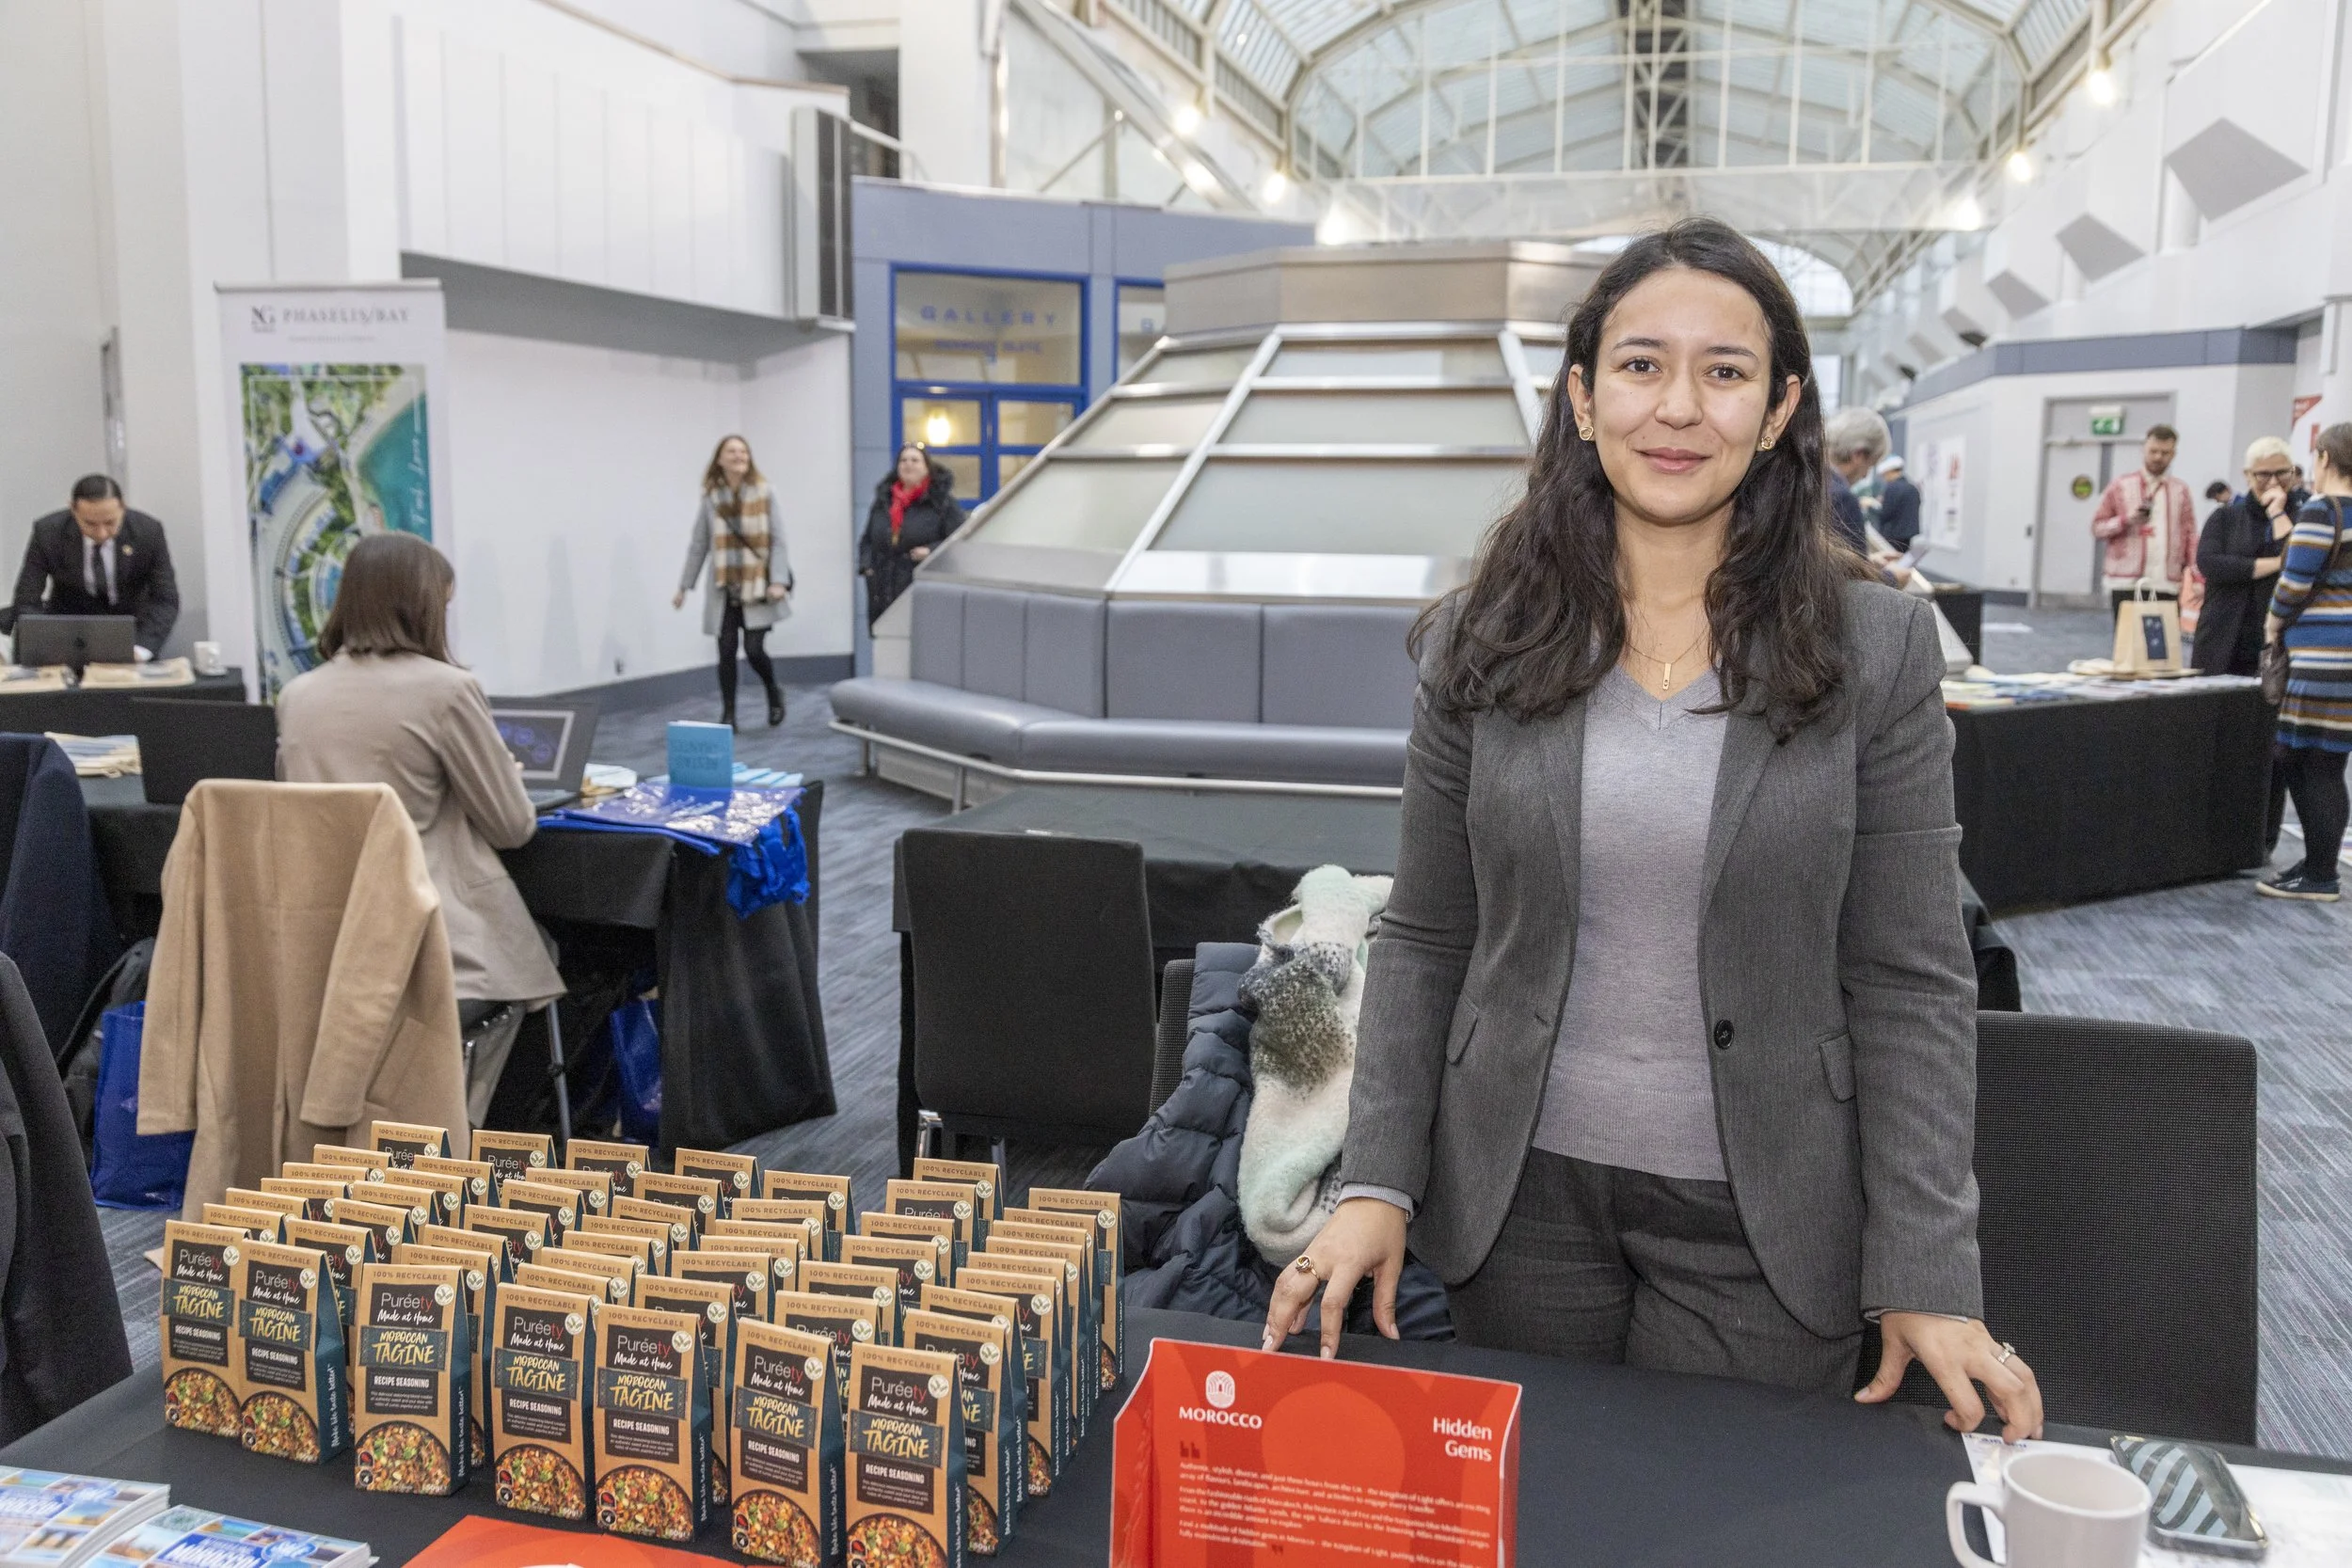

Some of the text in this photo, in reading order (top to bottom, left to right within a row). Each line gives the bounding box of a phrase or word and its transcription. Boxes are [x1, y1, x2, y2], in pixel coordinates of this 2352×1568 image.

[499, 1138, 539, 1148] RECYCLABLE
[595, 1149, 636, 1158] RECYCLABLE
[311, 1172, 355, 1180] RECYCLABLE
[554, 1178, 598, 1186] RECYCLABLE
[290, 1187, 334, 1196] RECYCLABLE
[664, 1181, 707, 1192] RECYCLABLE
[794, 1180, 838, 1189] RECYCLABLE
[379, 1193, 421, 1203] RECYCLABLE
[917, 1189, 963, 1197] RECYCLABLE
[1060, 1197, 1108, 1207] RECYCLABLE
[591, 1222, 659, 1235] 100% RECYCLABLE
[893, 1222, 942, 1232] RECYCLABLE
[192, 1231, 235, 1242] RECYCLABLE
[314, 1229, 356, 1242] RECYCLABLE
[593, 1242, 638, 1252] RECYCLABLE
[734, 1246, 785, 1255] RECYCLABLE
[875, 1246, 926, 1256] RECYCLABLE
[1019, 1248, 1070, 1259] RECYCLABLE
[268, 1252, 310, 1264] RECYCLABLE
[410, 1252, 477, 1266] 100% RECYCLABLE
[706, 1259, 756, 1268] RECYCLABLE
[1001, 1263, 1053, 1274] RECYCLABLE
[396, 1272, 447, 1281] RECYCLABLE
[527, 1274, 596, 1291] 100% RECYCLABLE
[810, 1270, 884, 1283] 100% RECYCLABLE
[179, 1285, 218, 1300] MOROCCAN
[646, 1283, 719, 1298] 100% RECYCLABLE
[991, 1279, 1042, 1291] RECYCLABLE
[173, 1295, 224, 1319] TAGINE
[506, 1293, 577, 1309] 100% RECYCLABLE
[787, 1302, 865, 1315] 100% RECYCLABLE
[256, 1307, 295, 1324] MOROCCAN
[377, 1308, 435, 1324] Made at Home
[608, 1311, 684, 1328] 100% RECYCLABLE
[175, 1324, 221, 1341] RECIPE SEASONING
[250, 1317, 301, 1341] TAGINE
[380, 1331, 428, 1343] MOROCCAN
[511, 1333, 565, 1352] Made at Home
[769, 1335, 817, 1354] RECYCLABLE
[252, 1347, 298, 1366] RECIPE SEASONING
[373, 1341, 434, 1366] TAGINE
[514, 1355, 560, 1371] MOROCCAN
[614, 1354, 673, 1371] Made at Home
[887, 1354, 941, 1370] RECYCLABLE
[374, 1376, 429, 1388] RECIPE SEASONING
[506, 1366, 566, 1392] TAGINE
[617, 1375, 666, 1389] MOROCCAN
[751, 1372, 804, 1396] Made at Home
[610, 1386, 674, 1411] TAGINE
[867, 1394, 929, 1416] Made at Home
[509, 1399, 562, 1416] RECIPE SEASONING
[754, 1396, 799, 1417] MOROCCAN
[746, 1407, 804, 1437] TAGINE
[1179, 1406, 1263, 1430] MOROCCO
[612, 1418, 670, 1435] RECIPE SEASONING
[871, 1418, 922, 1436] MOROCCAN
[1433, 1417, 1492, 1441] Hidden
[863, 1430, 929, 1458] TAGINE
[1445, 1439, 1492, 1462] Gems
[748, 1440, 800, 1464] RECIPE SEASONING
[866, 1464, 925, 1483] RECIPE SEASONING
